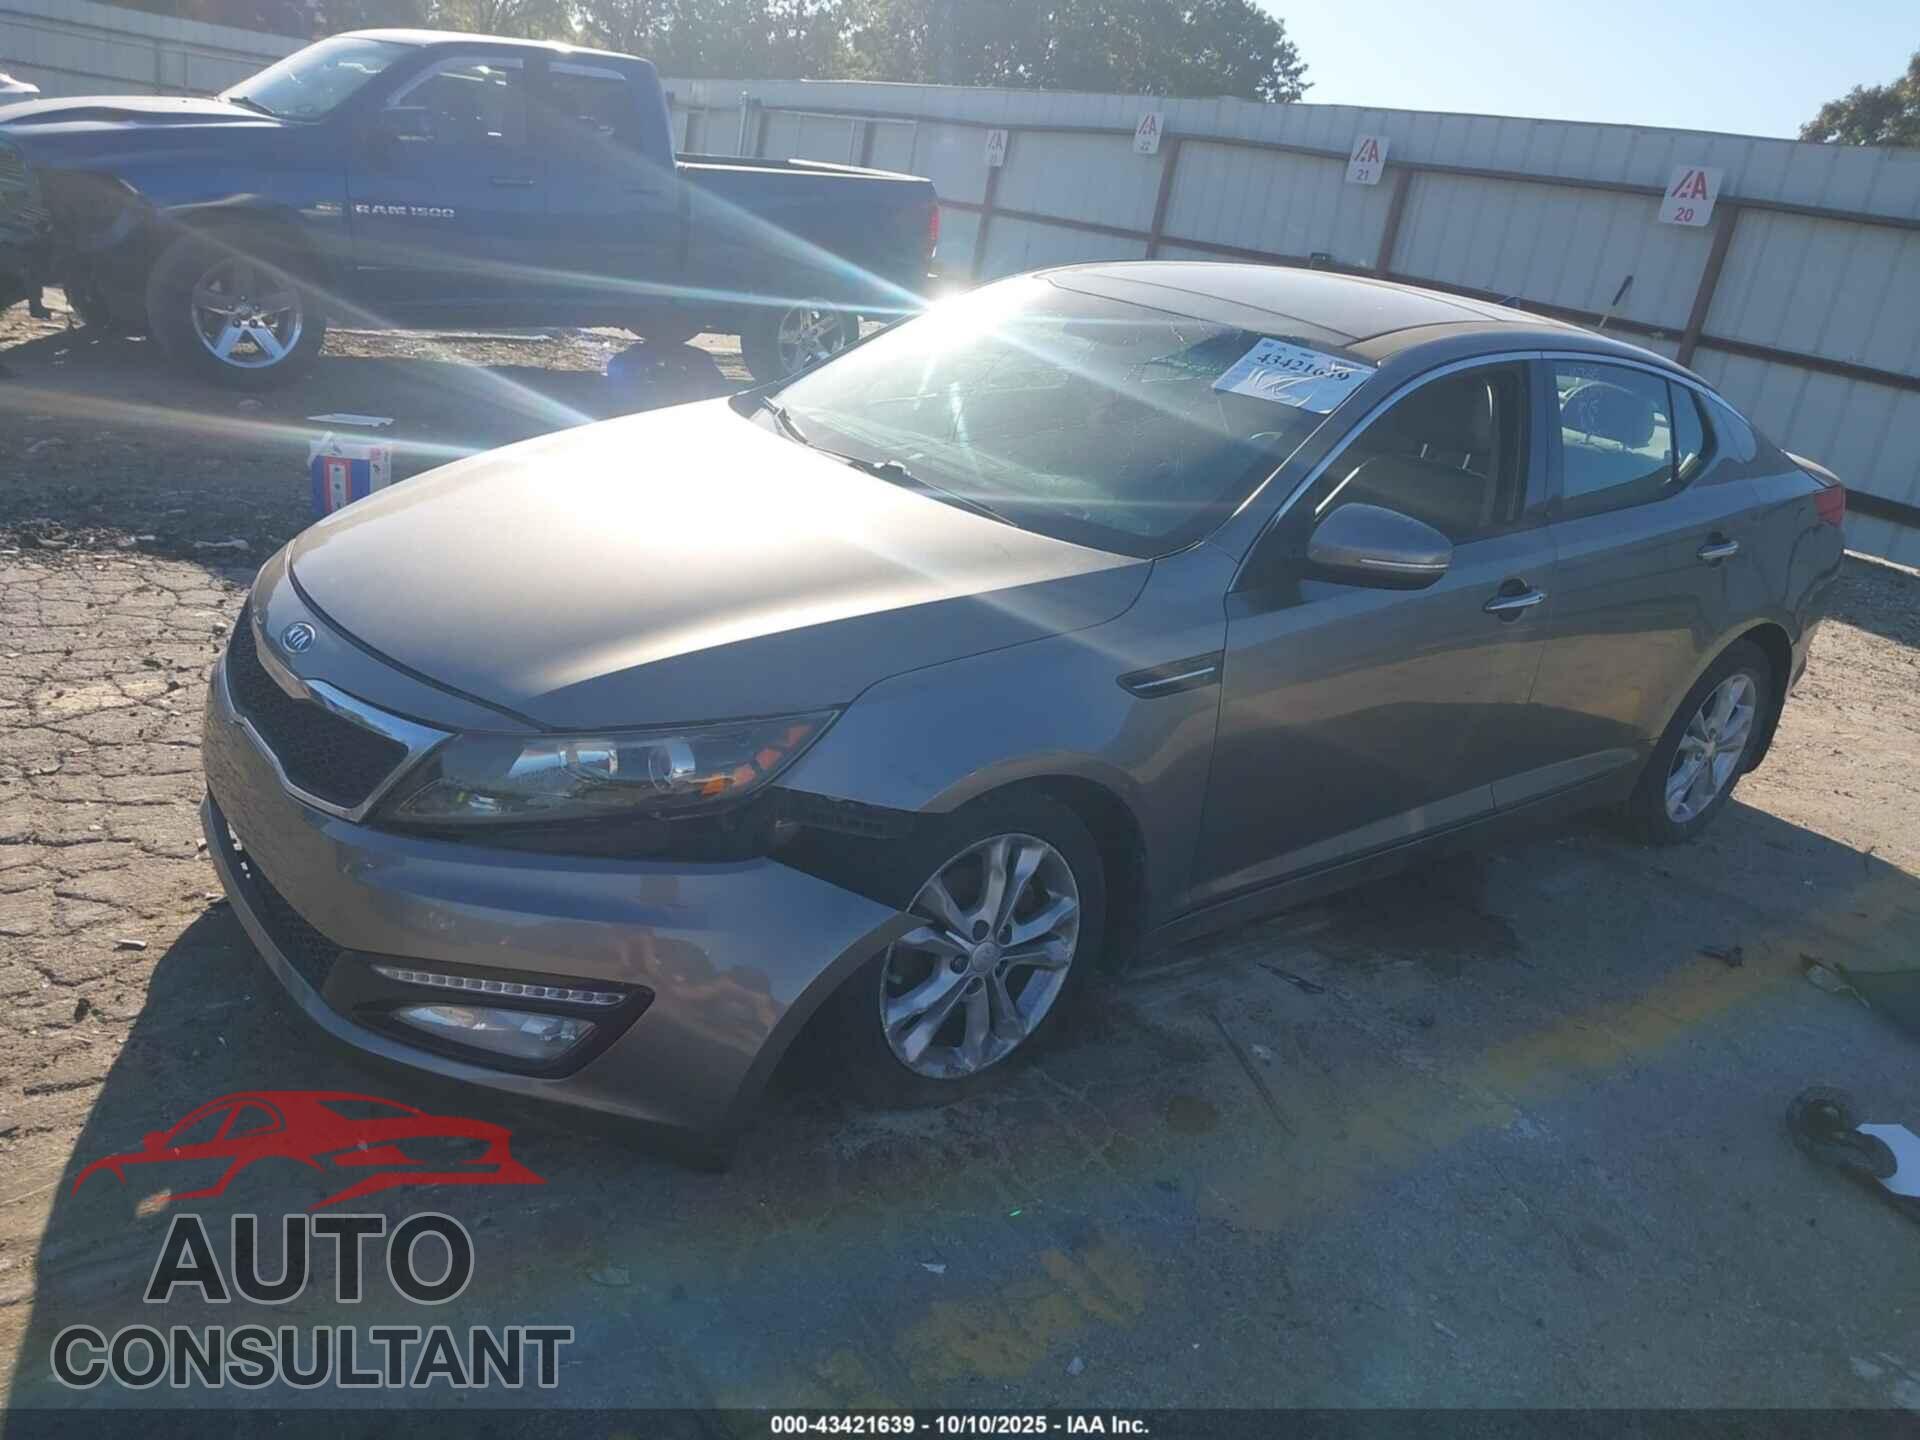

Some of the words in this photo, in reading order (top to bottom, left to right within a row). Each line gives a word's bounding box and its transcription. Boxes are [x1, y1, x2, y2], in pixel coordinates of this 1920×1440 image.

[1357, 168, 1369, 181] 21
[355, 203, 407, 216] RAM
[410, 206, 456, 218] 1500
[1673, 207, 1695, 222] 20
